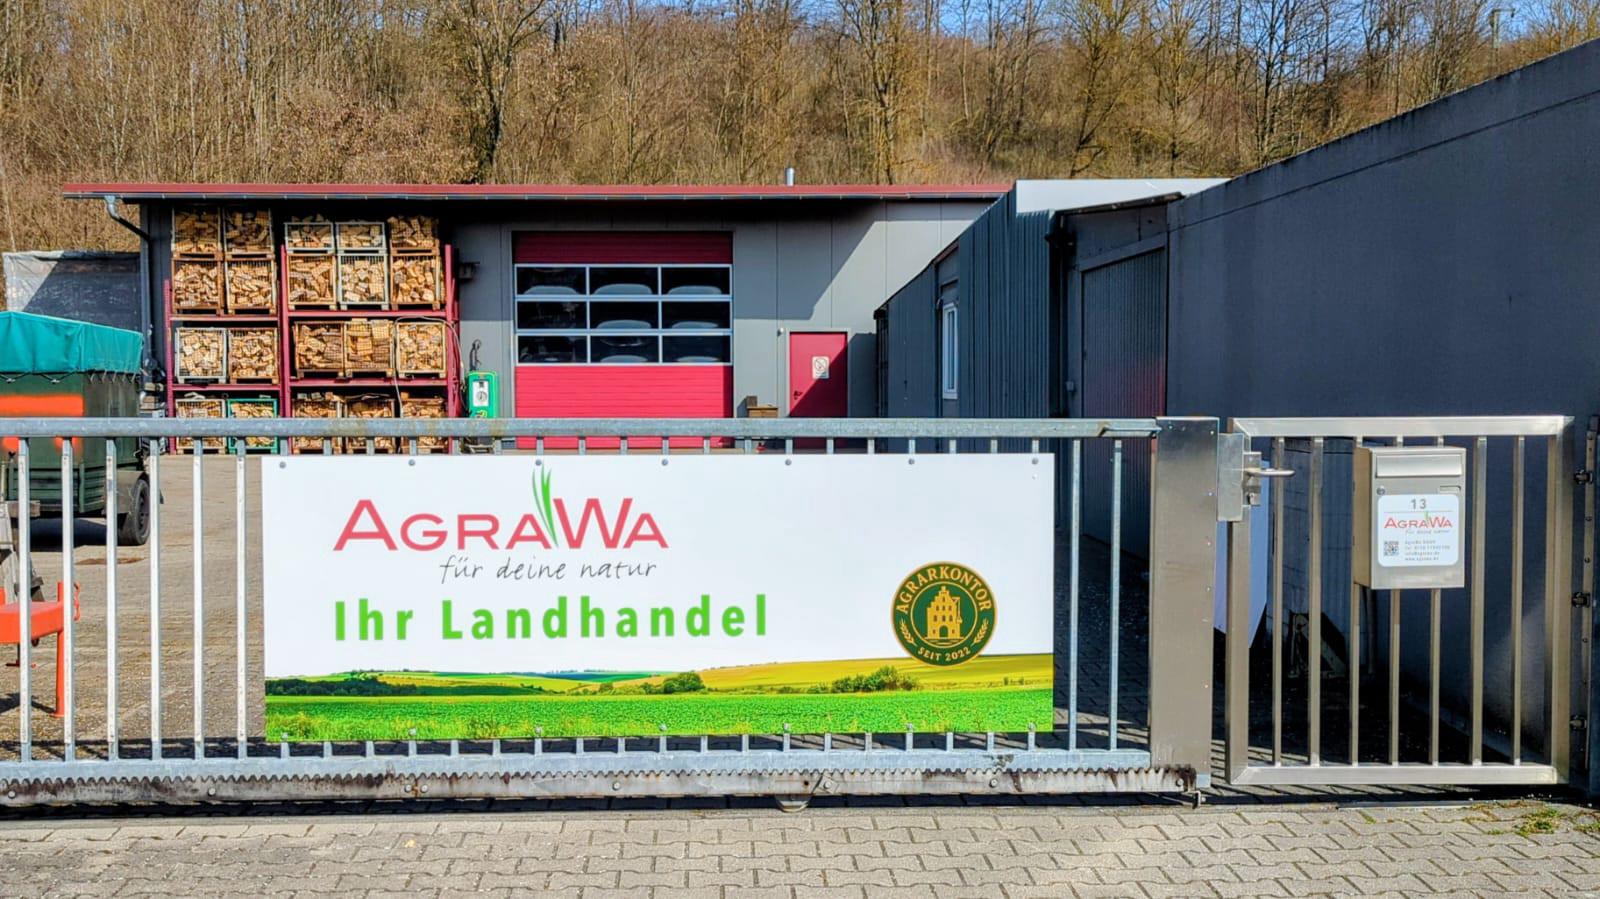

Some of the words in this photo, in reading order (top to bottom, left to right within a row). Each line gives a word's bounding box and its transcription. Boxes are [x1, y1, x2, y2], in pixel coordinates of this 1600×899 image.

[1410, 498, 1427, 510] 13
[439, 555, 484, 584] für
[496, 557, 567, 580] deine
[579, 561, 657, 579] natur
[896, 566, 992, 614] AGRARKONTOR
[334, 597, 414, 641] Ihr
[441, 593, 767, 641] Landhandel
[917, 648, 941, 661] SEIT
[945, 648, 971, 661] 2022
